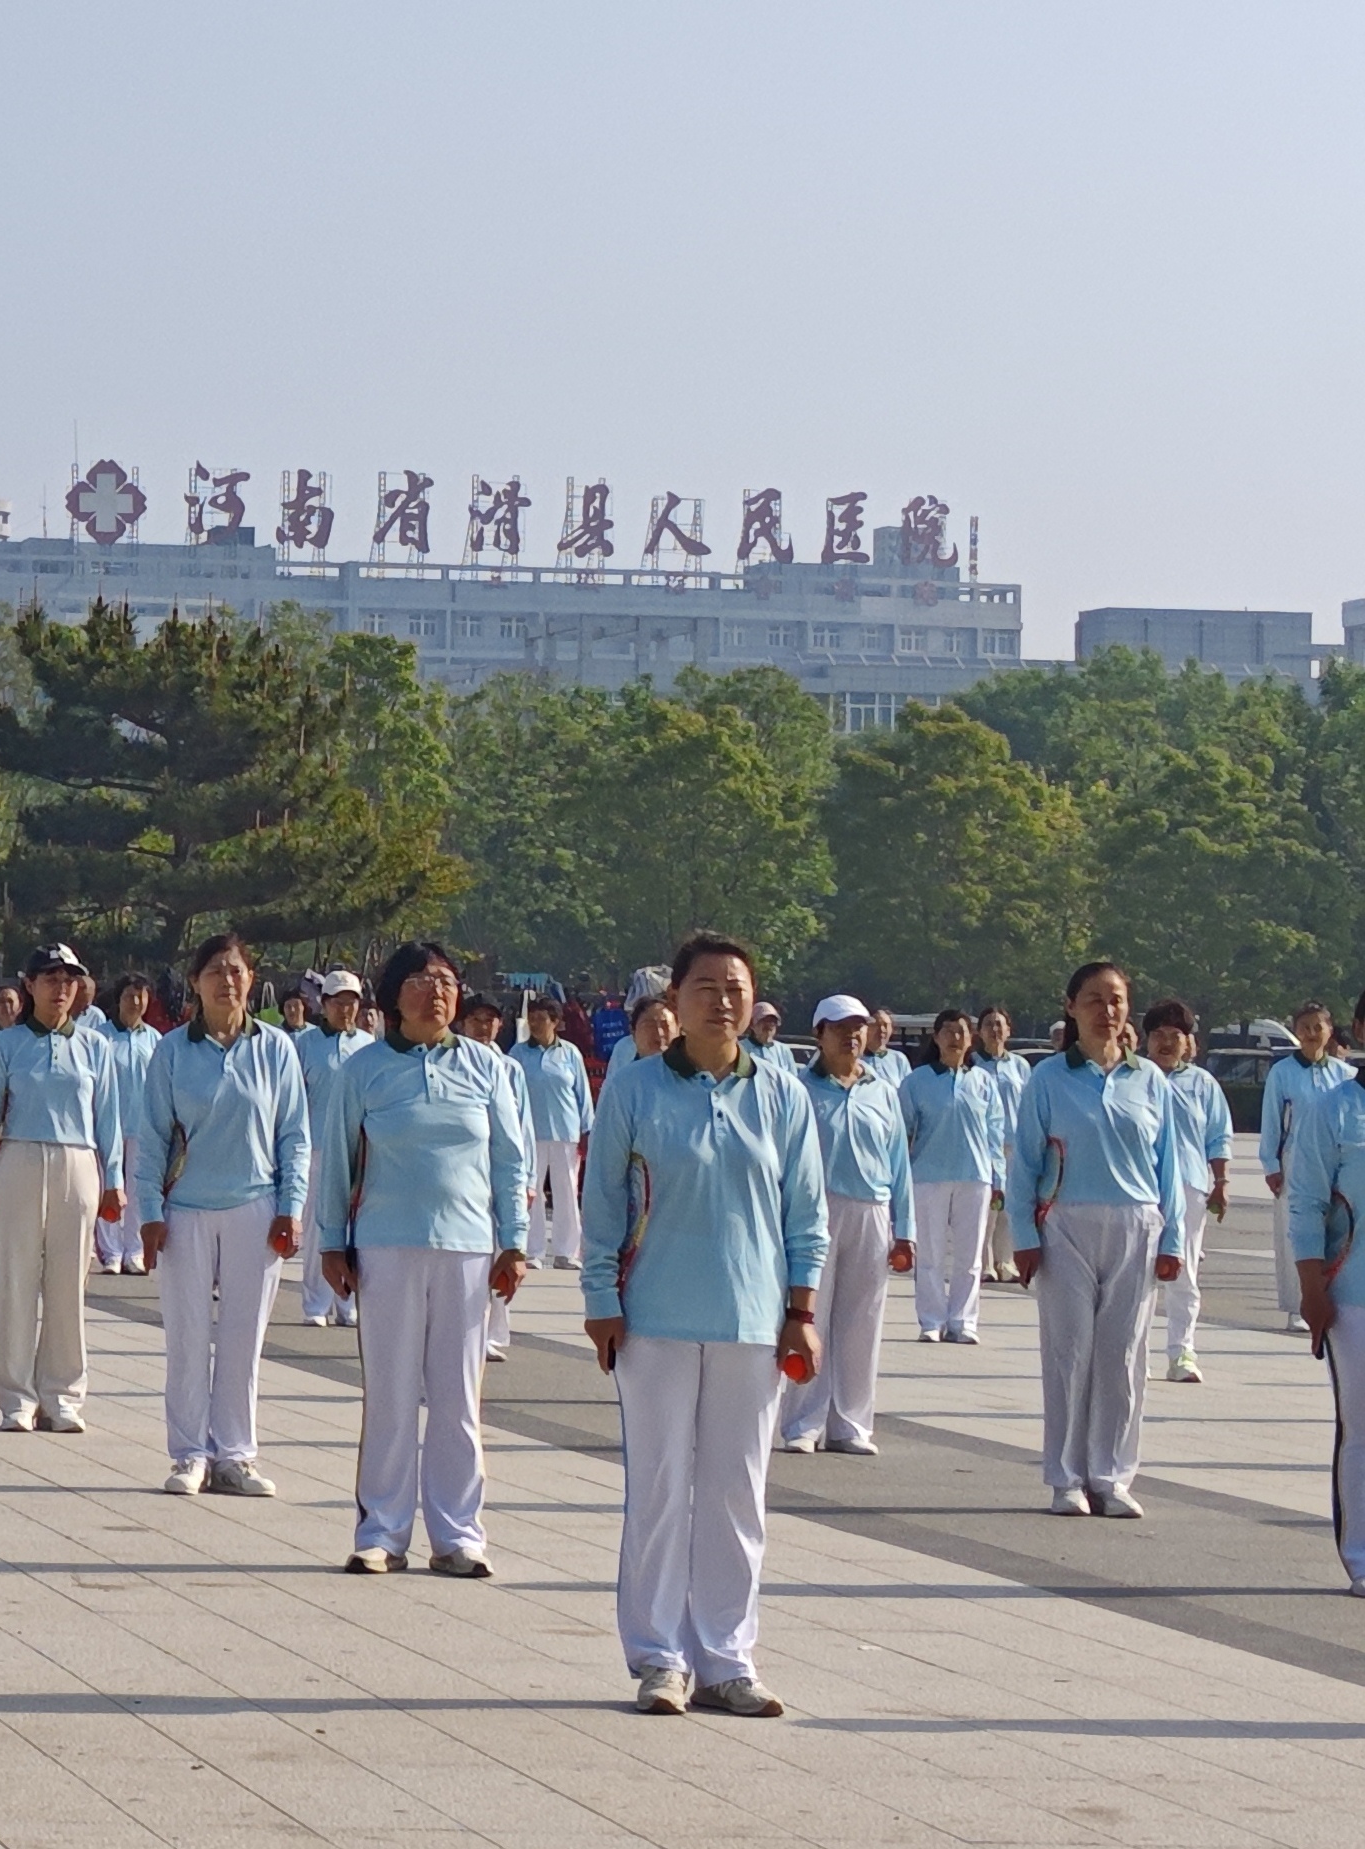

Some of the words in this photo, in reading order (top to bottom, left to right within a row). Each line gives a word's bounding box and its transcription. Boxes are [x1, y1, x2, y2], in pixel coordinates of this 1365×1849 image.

[184, 460, 959, 568] 河南省滑县人民医院
